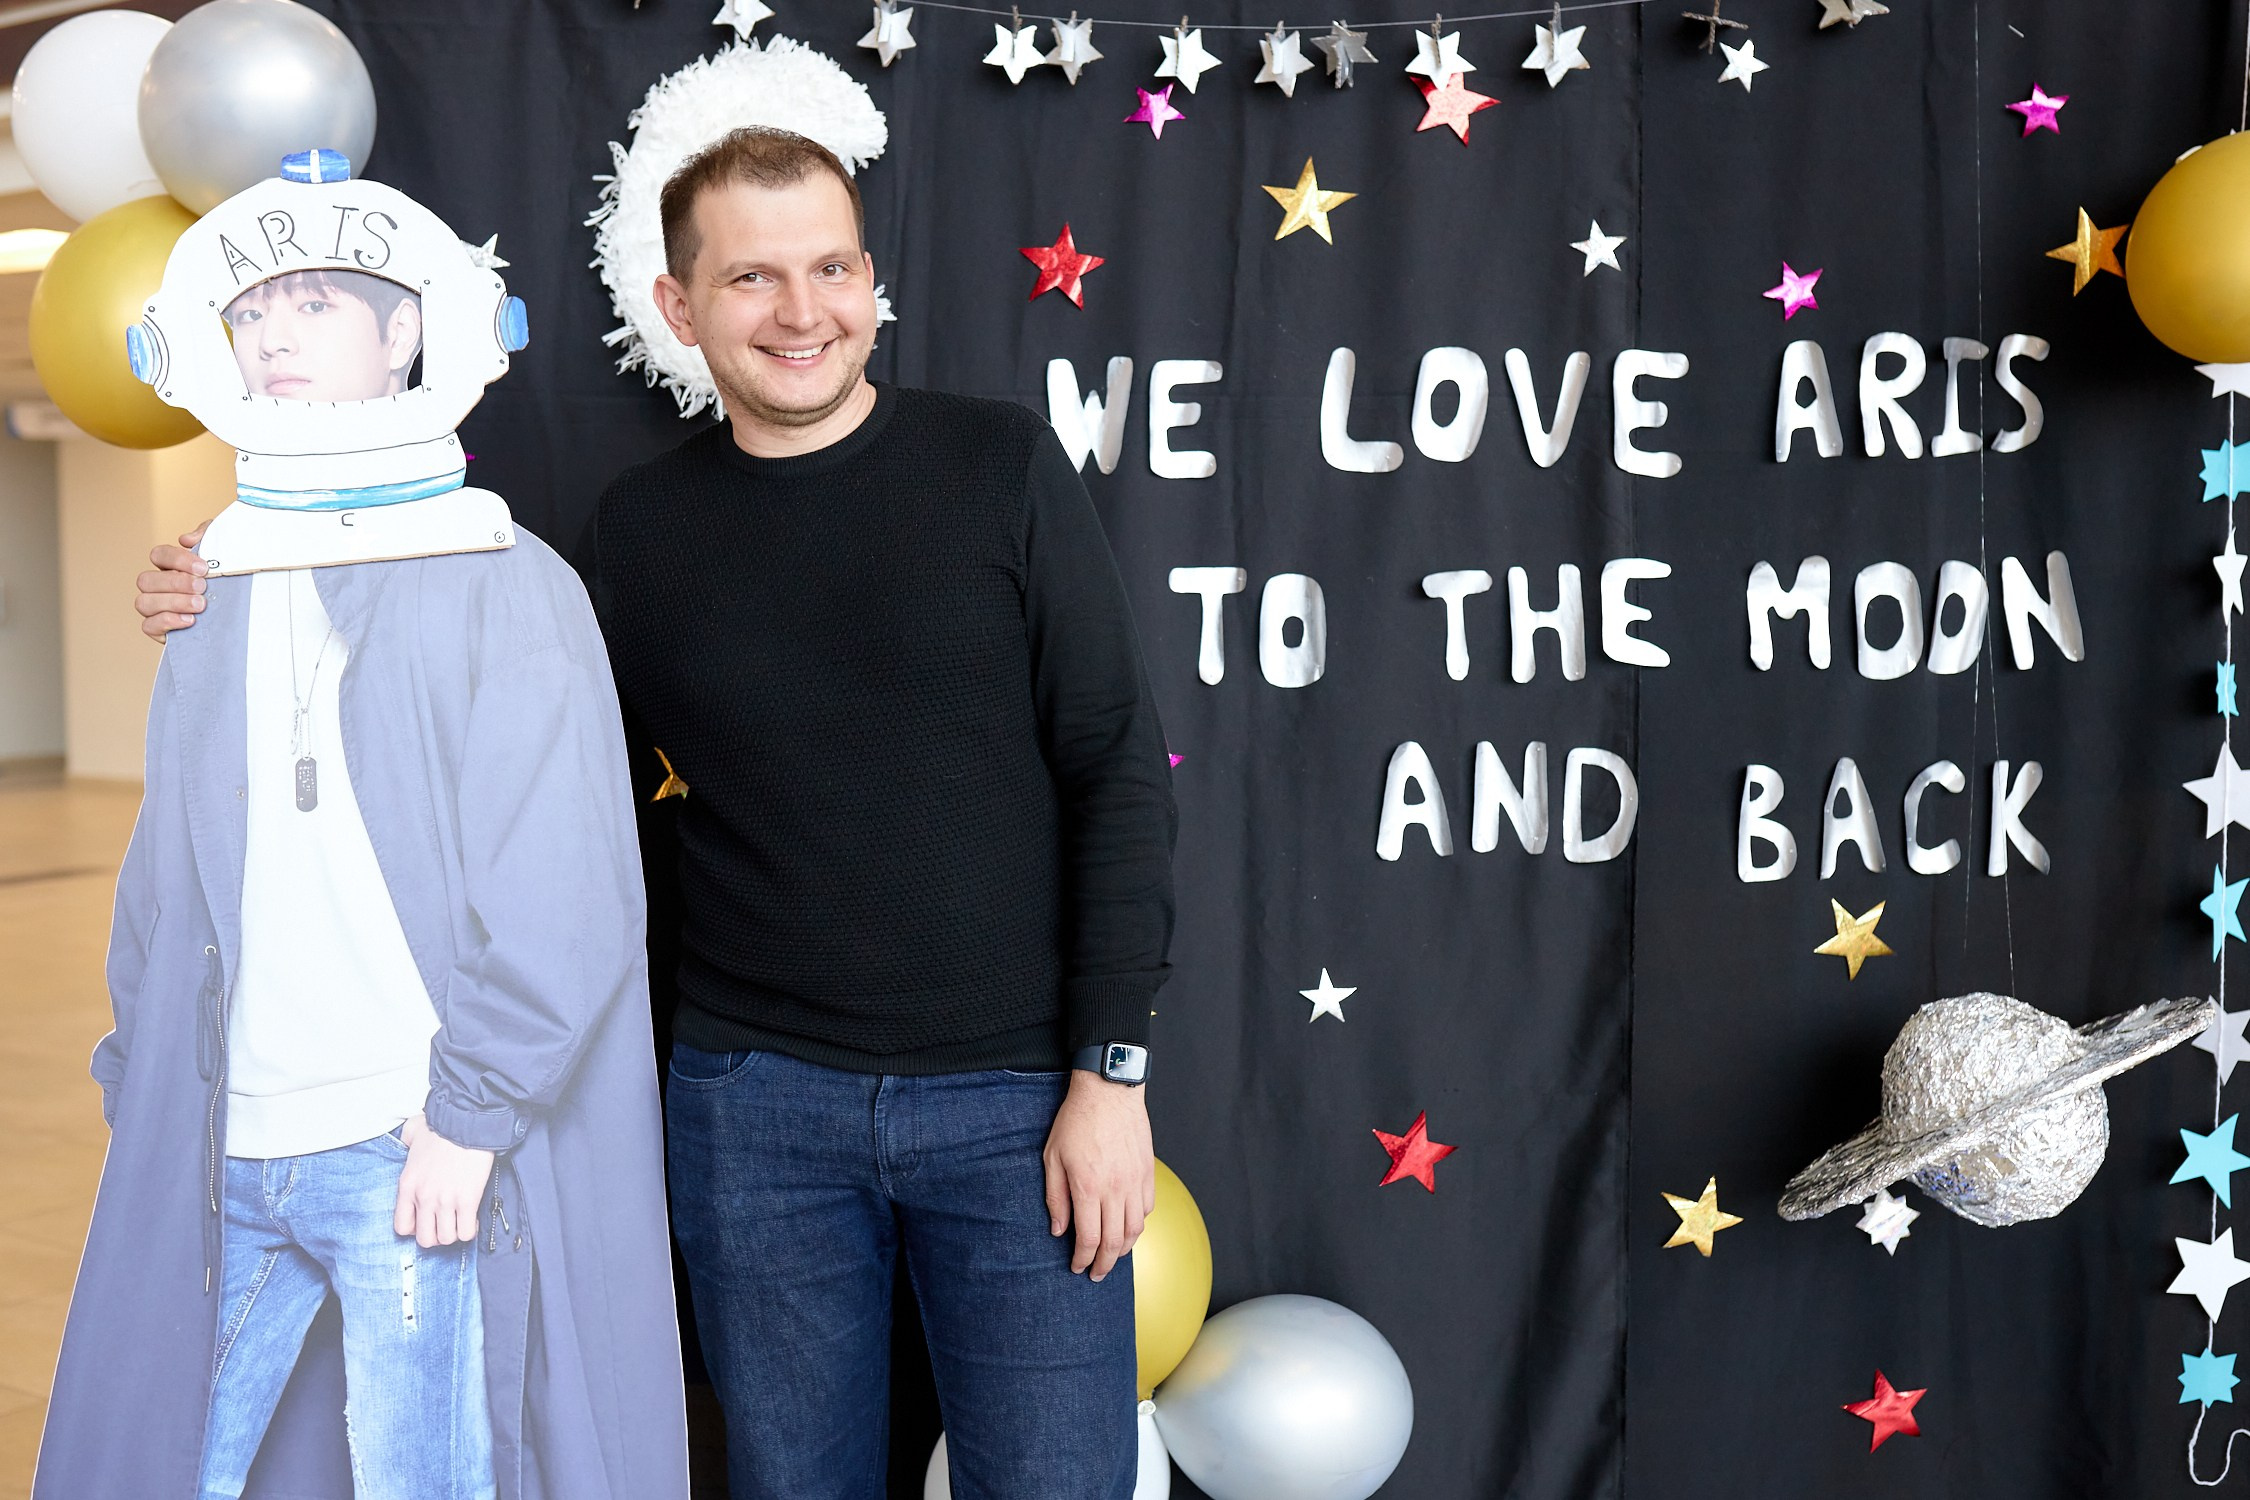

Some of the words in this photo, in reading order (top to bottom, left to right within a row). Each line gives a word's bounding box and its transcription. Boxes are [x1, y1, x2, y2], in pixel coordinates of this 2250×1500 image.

[219, 205, 397, 284] ARIS
[1047, 356, 1223, 479] WE
[1320, 347, 1689, 478] LOVE
[1775, 331, 2050, 463] ARIS
[1169, 567, 1327, 689] TO
[1422, 558, 1672, 684] THE
[1747, 550, 2085, 680] MOON
[1376, 741, 1638, 864] AND
[1738, 757, 2050, 883] BACK
